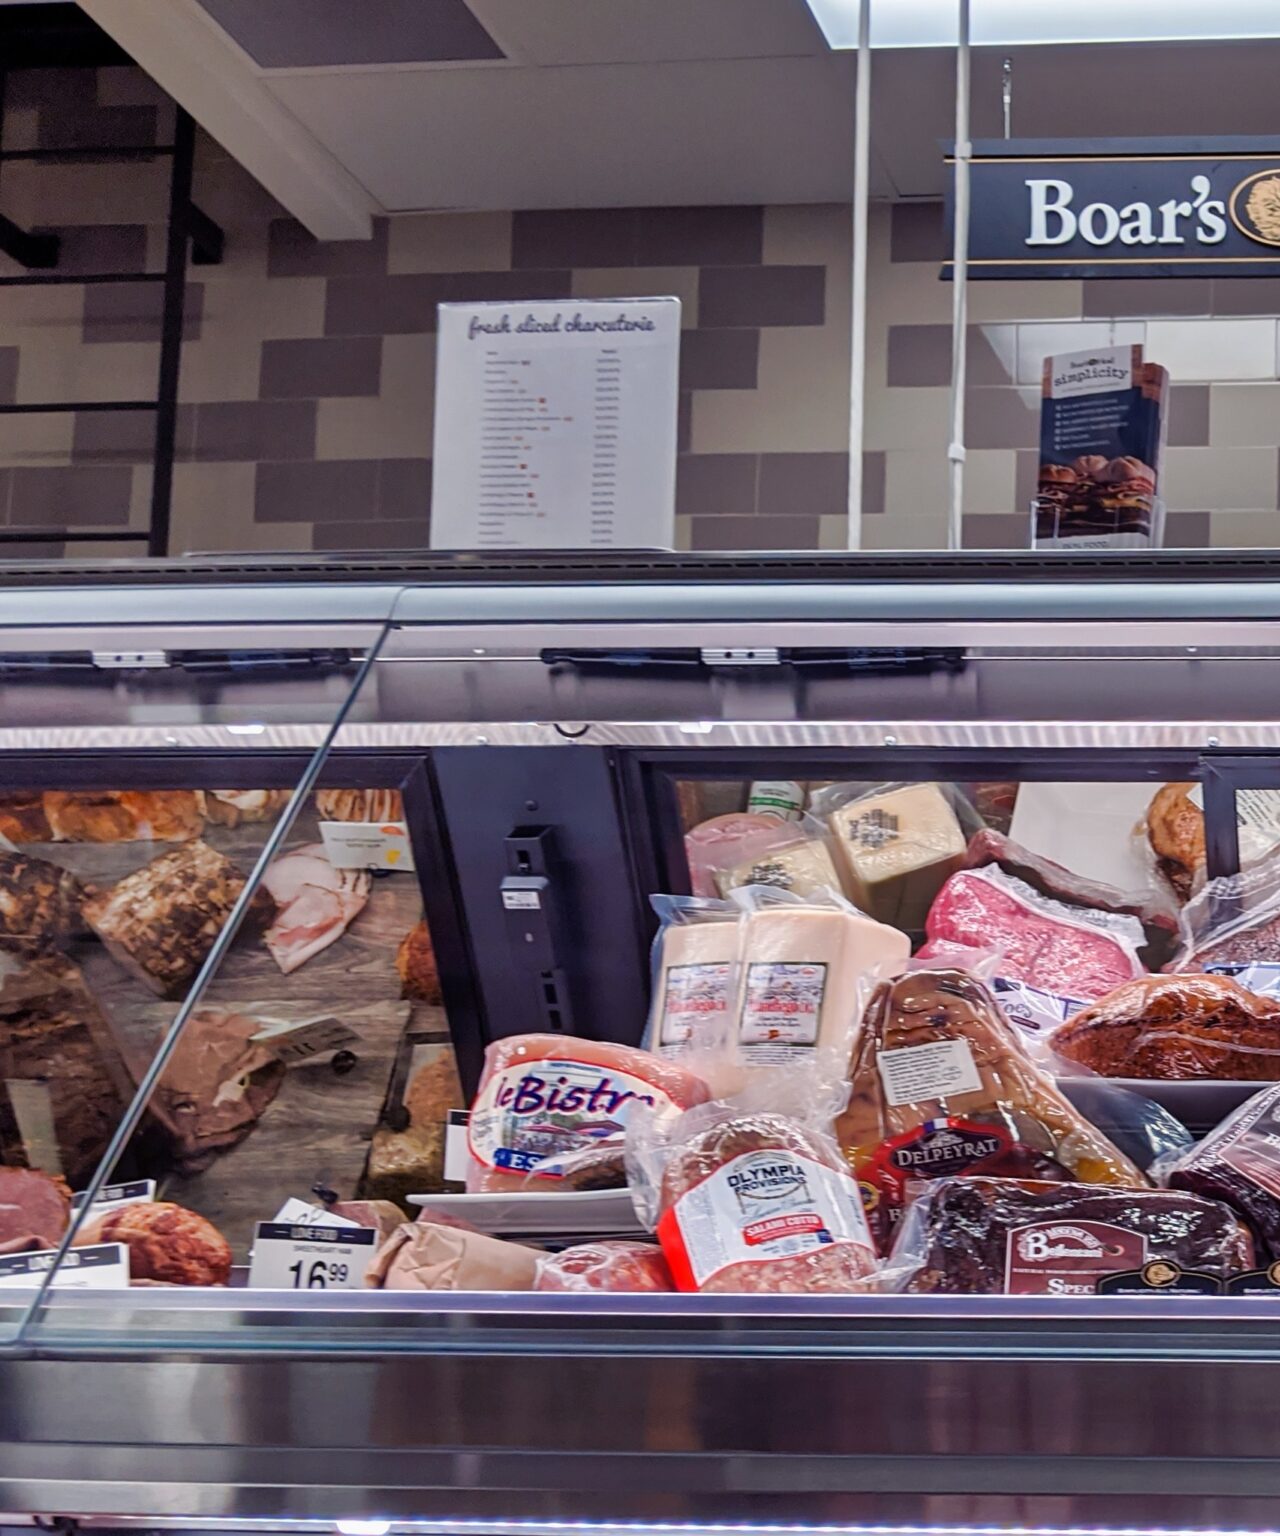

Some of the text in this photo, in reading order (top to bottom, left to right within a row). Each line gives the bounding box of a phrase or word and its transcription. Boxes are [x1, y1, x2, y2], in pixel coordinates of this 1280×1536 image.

[1025, 175, 1227, 246] Boar's
[468, 312, 656, 340] fresh sliced charcuterie
[1054, 366, 1129, 387] simplicity
[897, 1139, 997, 1166] DELPEYRAT
[727, 1165, 806, 1187] OLYMPIA
[734, 1177, 807, 1193] PROVISIONS
